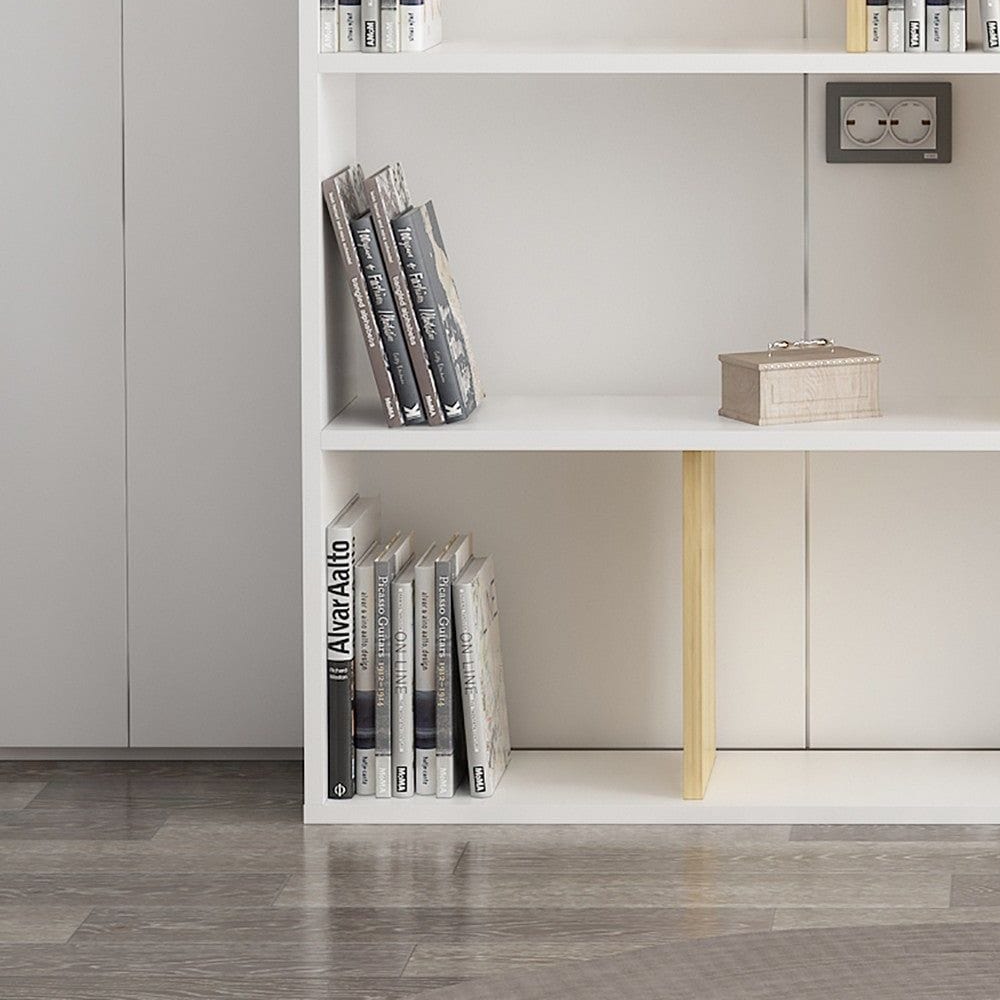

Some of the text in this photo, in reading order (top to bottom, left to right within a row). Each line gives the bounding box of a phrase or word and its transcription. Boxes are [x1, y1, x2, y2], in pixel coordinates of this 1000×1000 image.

[911, 22, 919, 47] MoMA
[988, 22, 998, 46] MoMA
[352, 278, 375, 347] tangled alphabets
[393, 276, 416, 345] tangled alphabets
[327, 541, 350, 597] Aalto
[378, 577, 388, 615] Picasso
[439, 577, 448, 615] Picasso
[327, 599, 350, 654] Alvar
[378, 617, 389, 658] Guitars
[395, 632, 407, 652] ON
[439, 617, 449, 658] Guitars
[460, 633, 473, 653] ON
[395, 661, 407, 694] LINE
[462, 662, 477, 695] LINE
[398, 767, 406, 791] MoMA
[475, 767, 484, 791] MoMA
